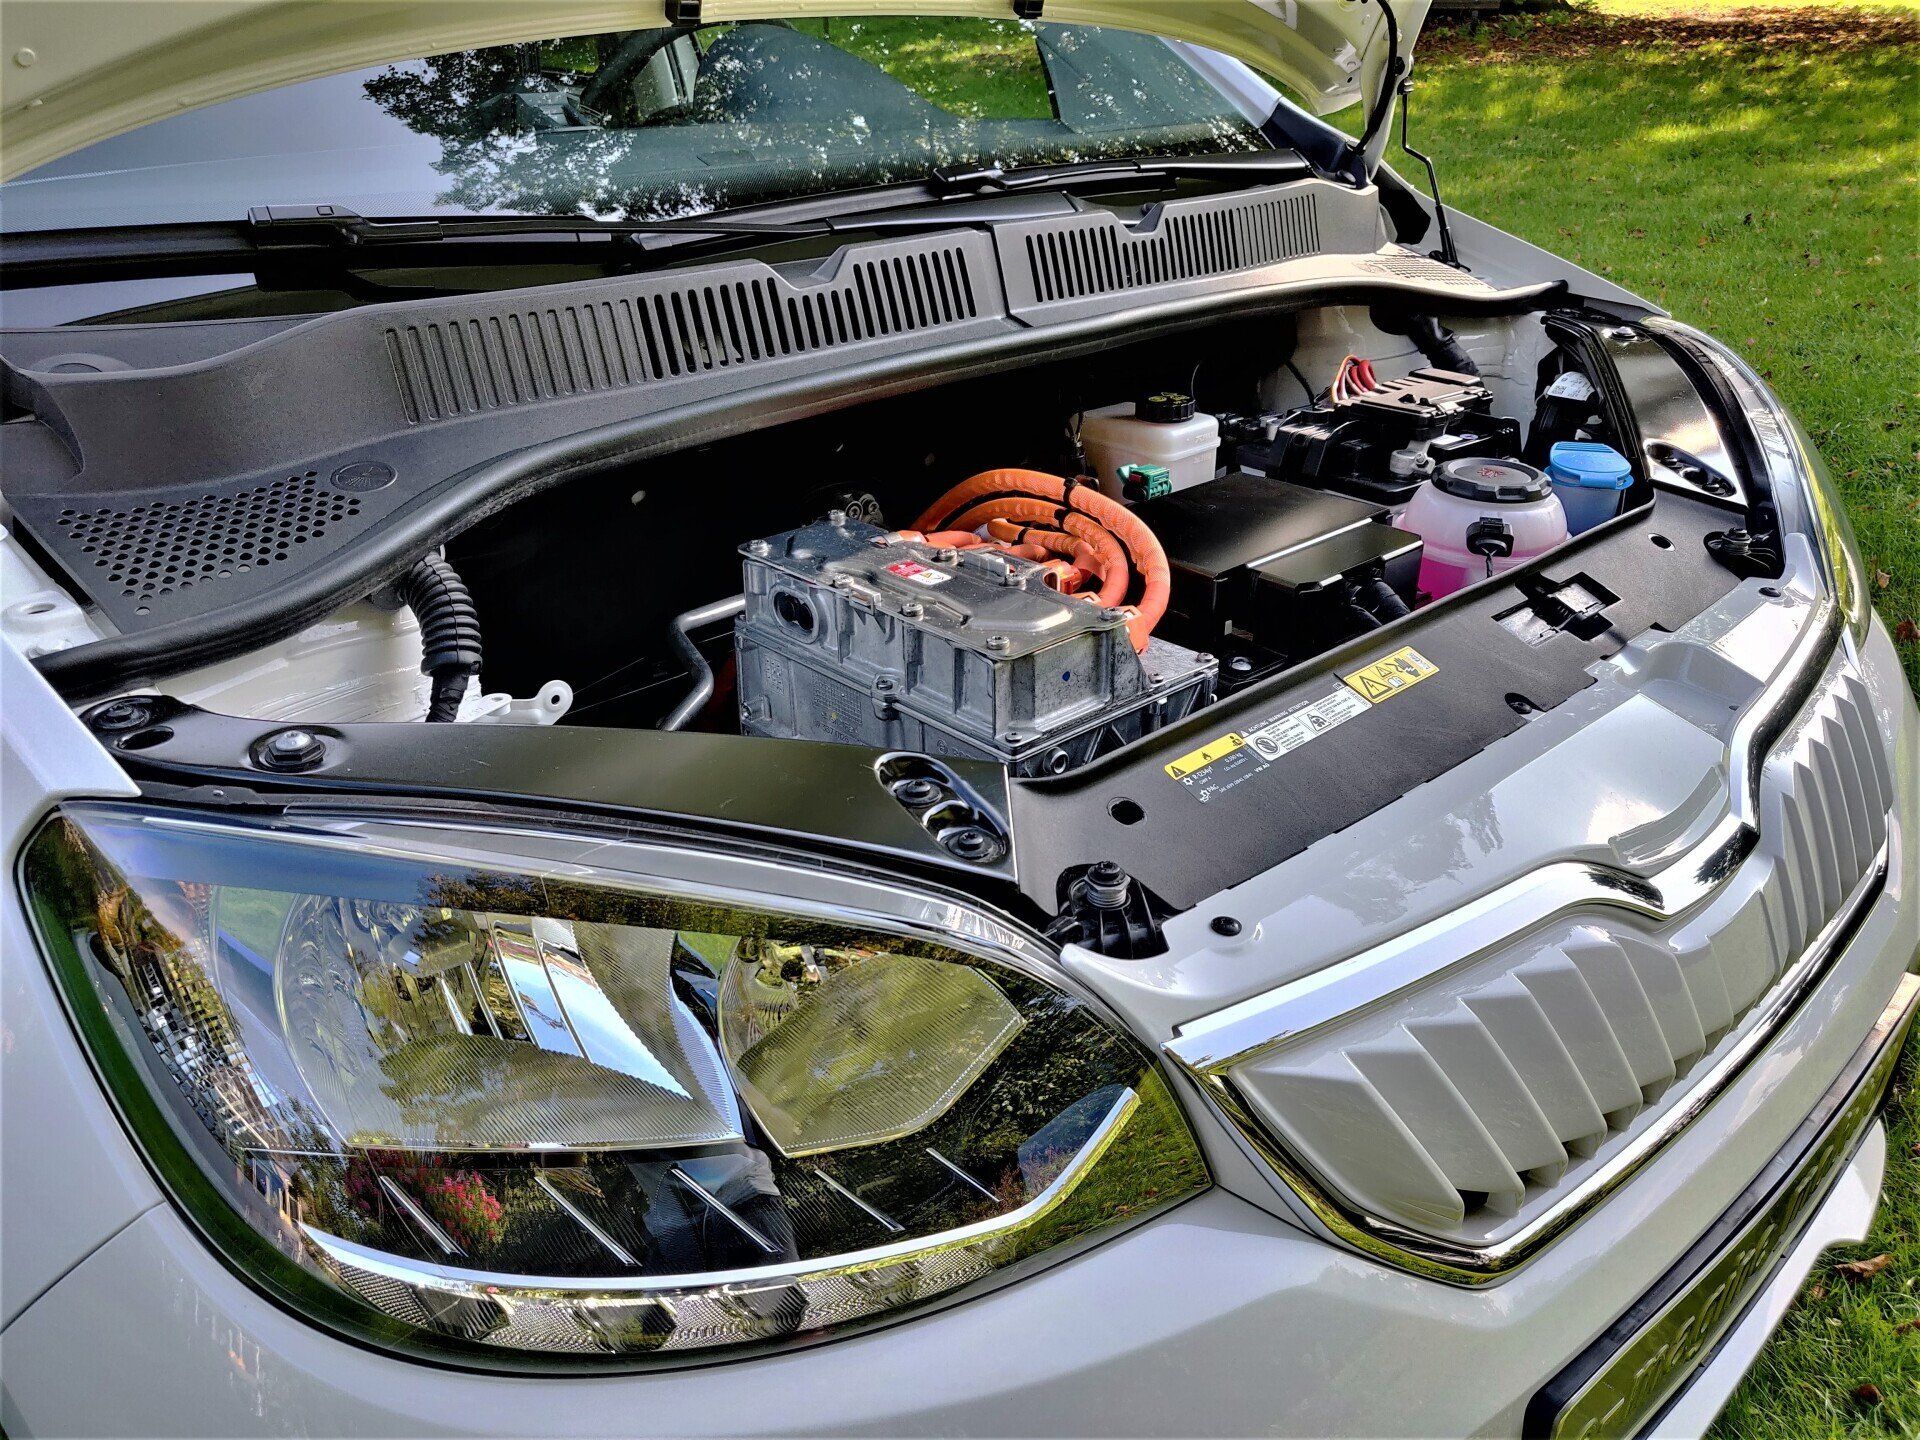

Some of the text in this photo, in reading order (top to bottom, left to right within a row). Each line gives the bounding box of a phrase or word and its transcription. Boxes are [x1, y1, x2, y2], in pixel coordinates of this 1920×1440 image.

[1248, 700, 1309, 733] ACHTUNG WARNING ATTENTION
[1192, 765, 1214, 780] R-1234yf
[1206, 783, 1220, 792] PAG
